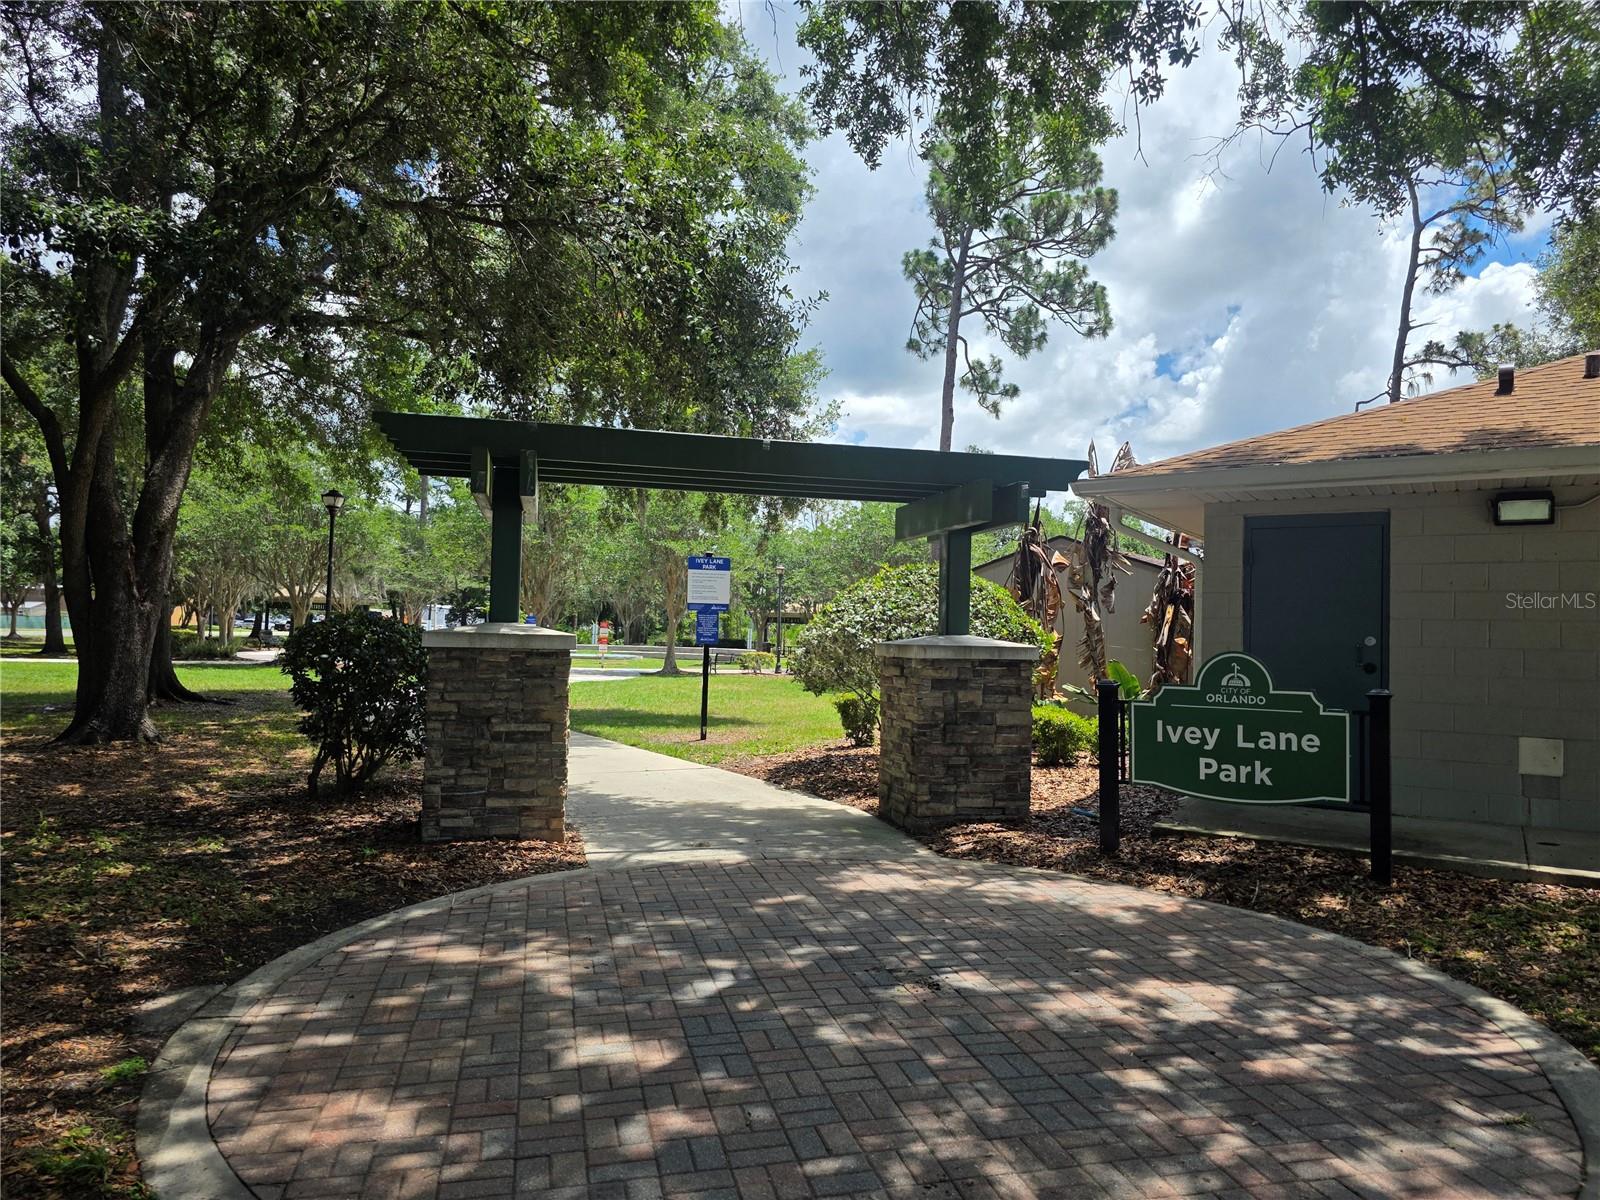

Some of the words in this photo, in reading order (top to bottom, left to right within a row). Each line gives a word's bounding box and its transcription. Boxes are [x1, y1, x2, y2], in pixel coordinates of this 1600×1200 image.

[1206, 693, 1266, 705] ORLANDO
[1156, 719, 1221, 750] Ivey
[1236, 724, 1321, 752] Lane
[1199, 757, 1273, 786] Park
